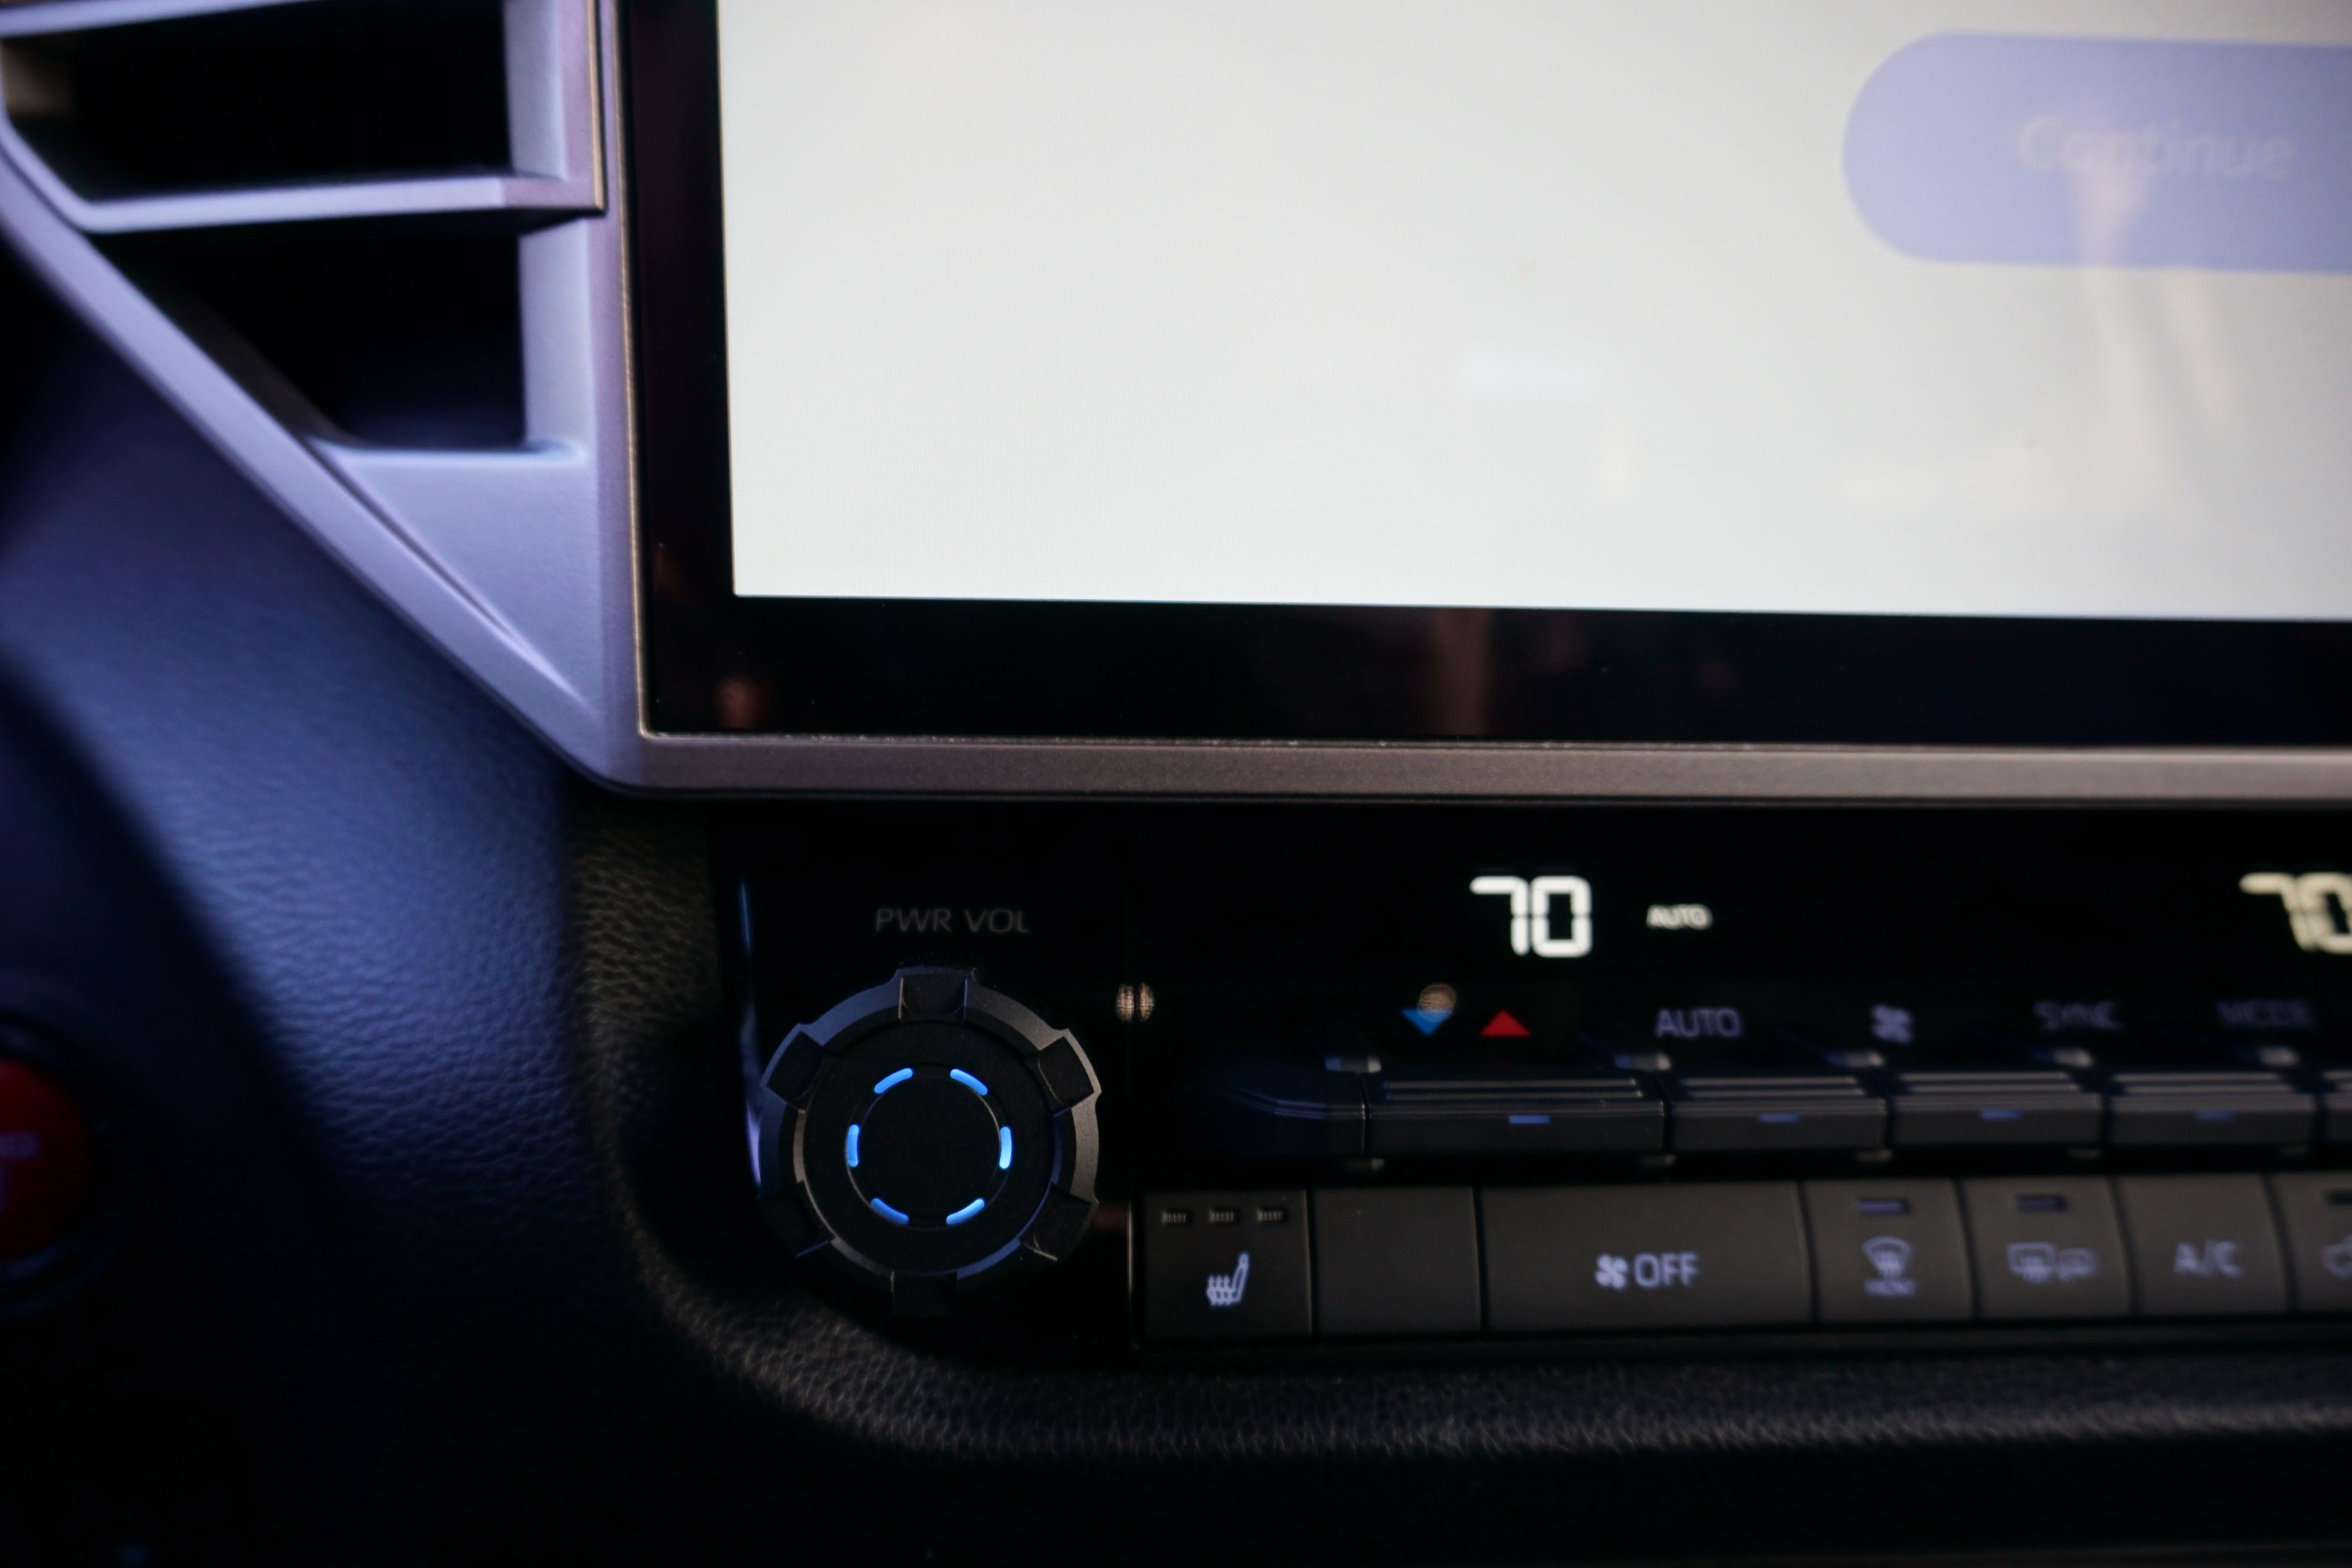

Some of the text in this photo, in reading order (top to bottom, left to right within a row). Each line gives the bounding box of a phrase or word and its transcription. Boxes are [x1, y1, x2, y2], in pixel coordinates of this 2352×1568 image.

[2017, 115, 2296, 179] Continue
[874, 907, 1031, 934] PWR VOL
[1469, 875, 1592, 958] 70
[1646, 904, 1713, 929] AUTO
[1655, 1007, 1744, 1039] AUTO
[1632, 1251, 1701, 1289] OFF
[2172, 1239, 2244, 1279] A/C
